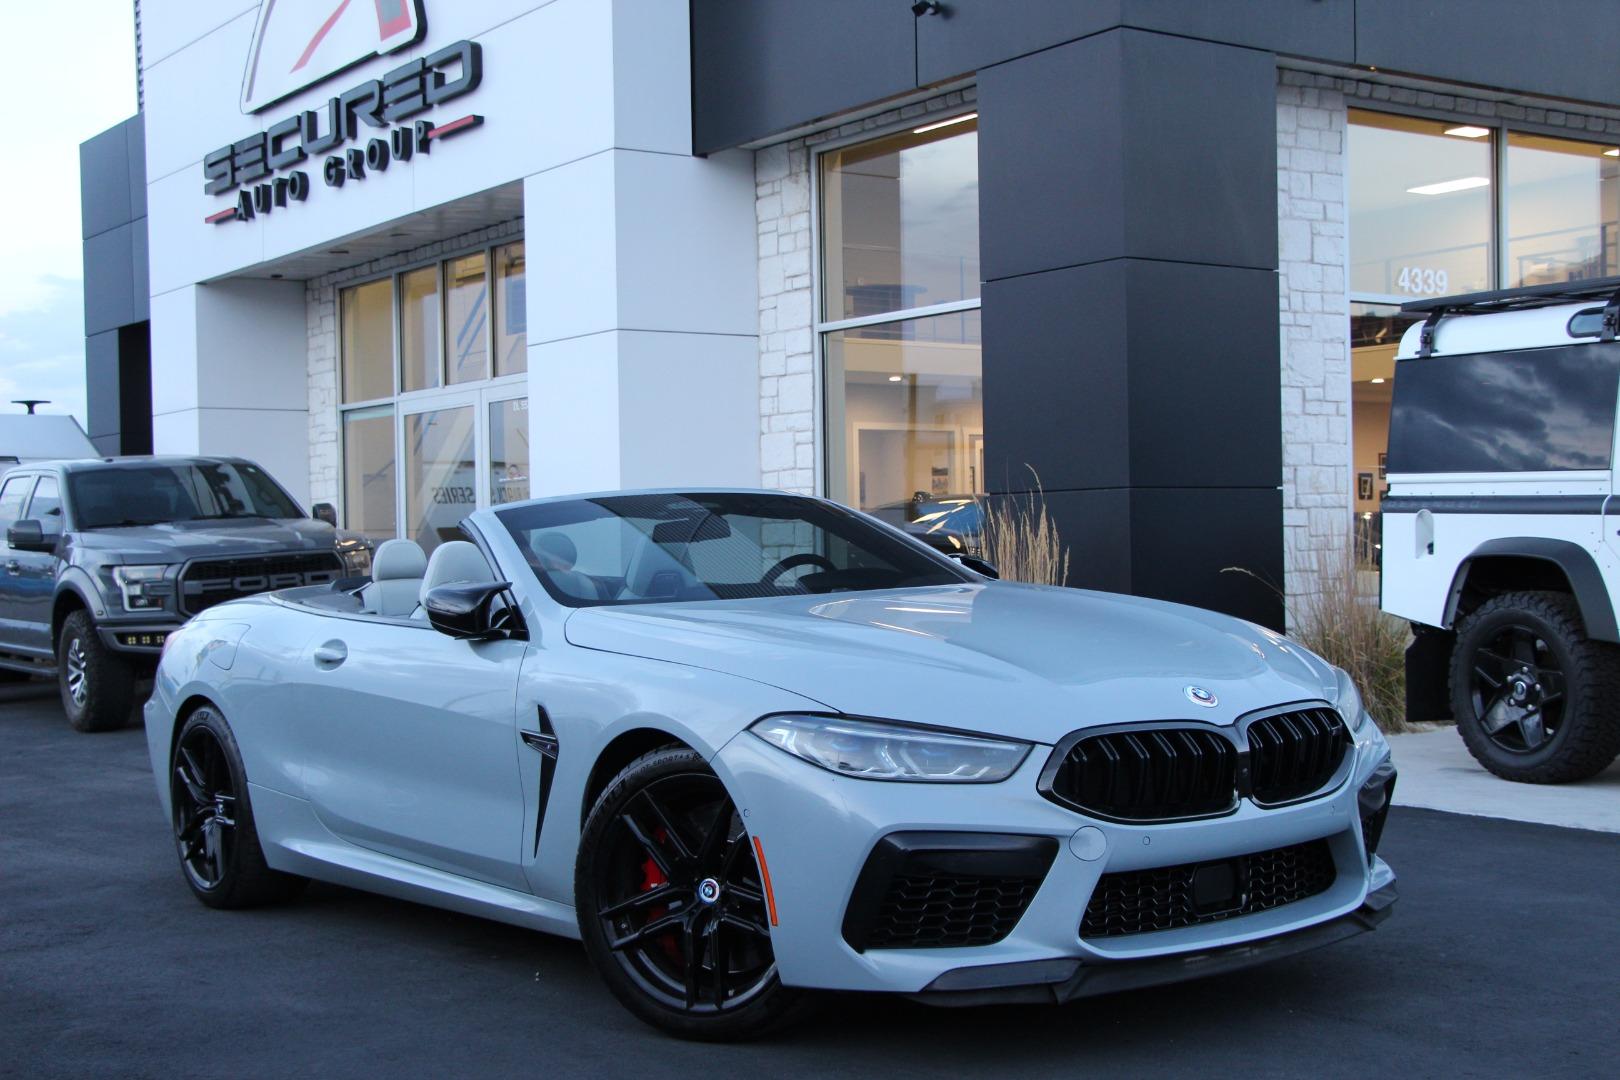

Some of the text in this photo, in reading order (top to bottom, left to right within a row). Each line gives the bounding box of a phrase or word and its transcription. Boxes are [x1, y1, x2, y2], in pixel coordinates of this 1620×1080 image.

[203, 39, 483, 195] SECURED
[236, 120, 435, 221] AUTO GROUP
[1398, 266, 1448, 294] 4339
[183, 569, 345, 594] FORD
